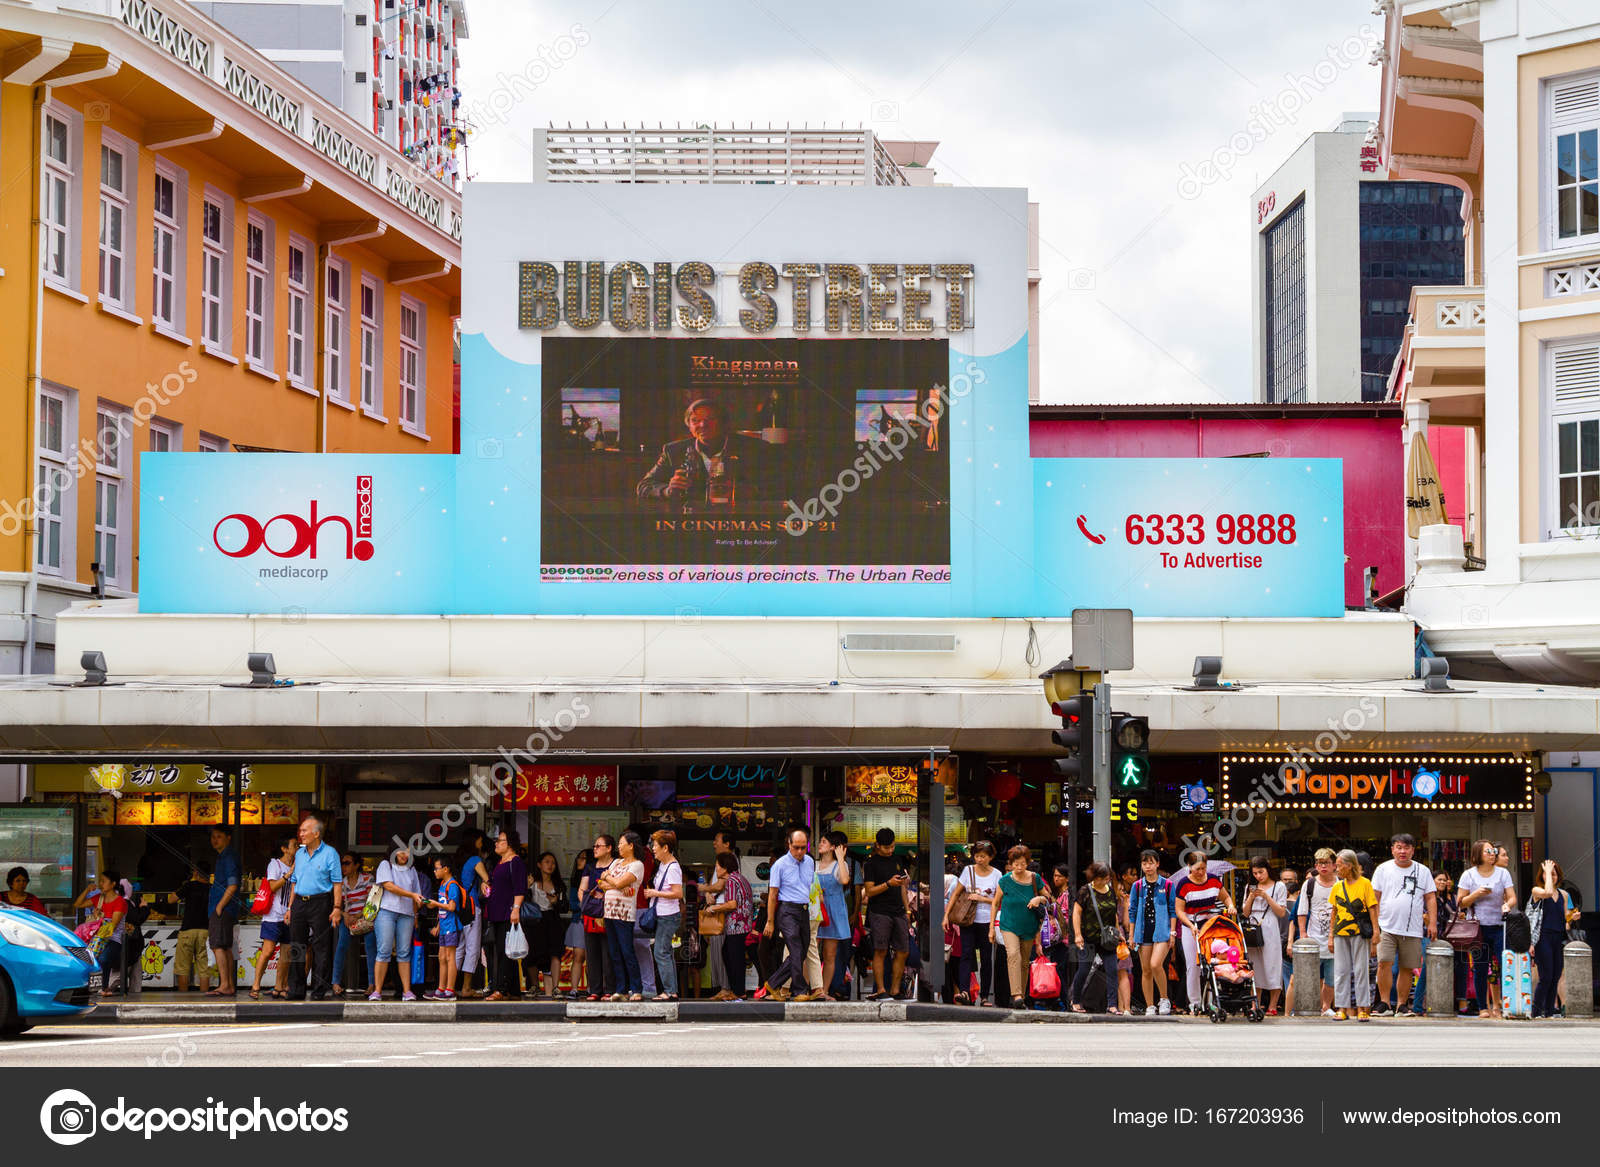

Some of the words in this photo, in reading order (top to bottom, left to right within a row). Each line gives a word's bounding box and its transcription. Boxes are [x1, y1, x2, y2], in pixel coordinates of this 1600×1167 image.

[519, 261, 716, 332] BUGIS
[738, 261, 975, 332] STREET
[691, 355, 800, 373] Kingsman
[655, 519, 676, 532] IN
[681, 519, 771, 532] CINEMAS
[818, 520, 836, 532] 21
[1125, 513, 1206, 545] 6333
[1216, 513, 1297, 545] 9888
[1159, 552, 1179, 569] To
[1183, 551, 1263, 569] Advertise
[259, 565, 329, 581] mediacorp
[668, 568, 686, 581] of
[688, 569, 744, 581] various
[747, 569, 819, 583] precincts.
[826, 569, 855, 581] The
[860, 569, 907, 581] Urban
[850, 794, 865, 804] Lau
[866, 794, 877, 804] Pa
[877, 794, 891, 804] Sat
